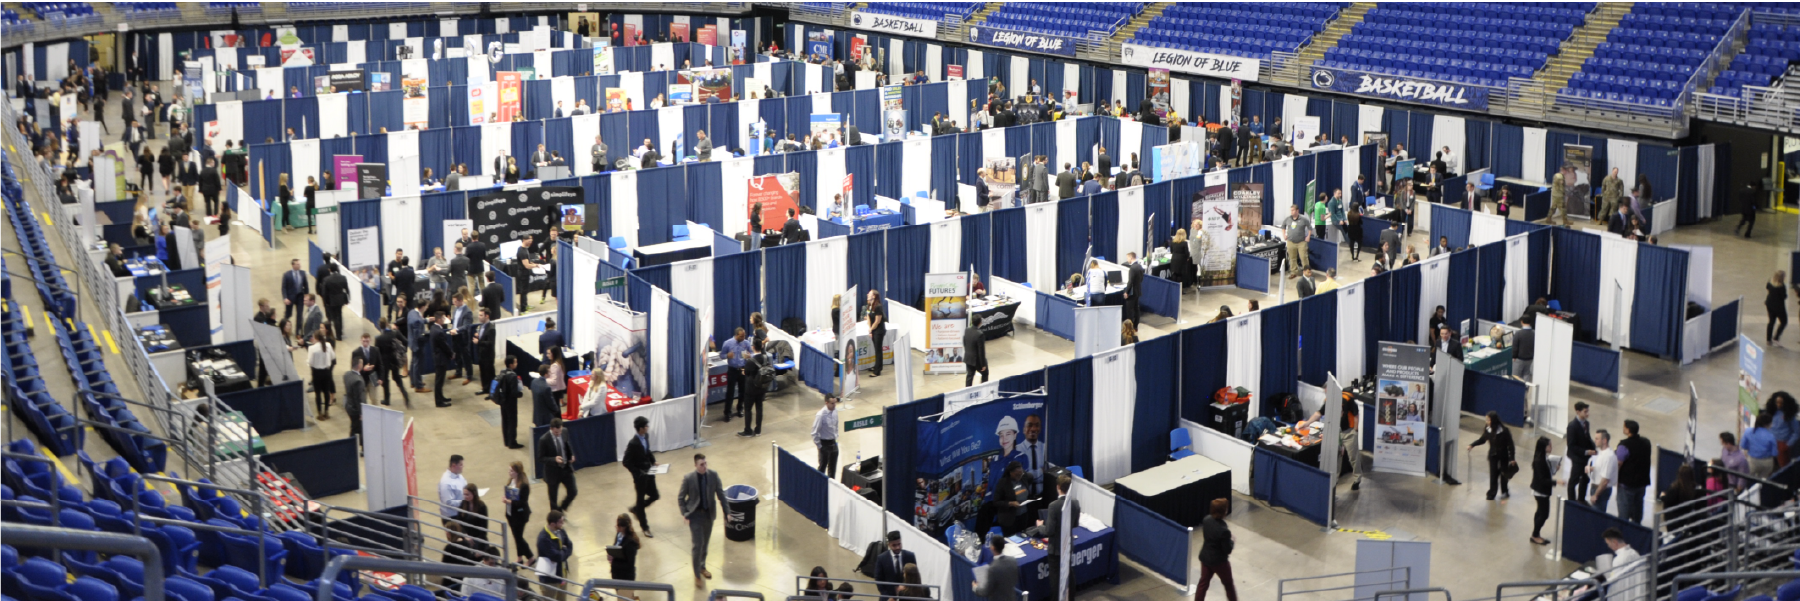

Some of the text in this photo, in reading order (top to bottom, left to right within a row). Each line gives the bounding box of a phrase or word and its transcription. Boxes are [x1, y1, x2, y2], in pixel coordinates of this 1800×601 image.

[872, 17, 924, 33] BASKETBALL
[992, 31, 1063, 50] LEGION OF BLUE
[1152, 52, 1242, 72] LEGION OF BLUE
[1354, 74, 1468, 104] BASKETBALL
[1013, 402, 1043, 410] Schlumberger
[853, 420, 868, 428] AISLE
[940, 455, 951, 467] What
[961, 446, 970, 454] You
[971, 440, 981, 451] Be?
[1038, 543, 1103, 580] Scberger
